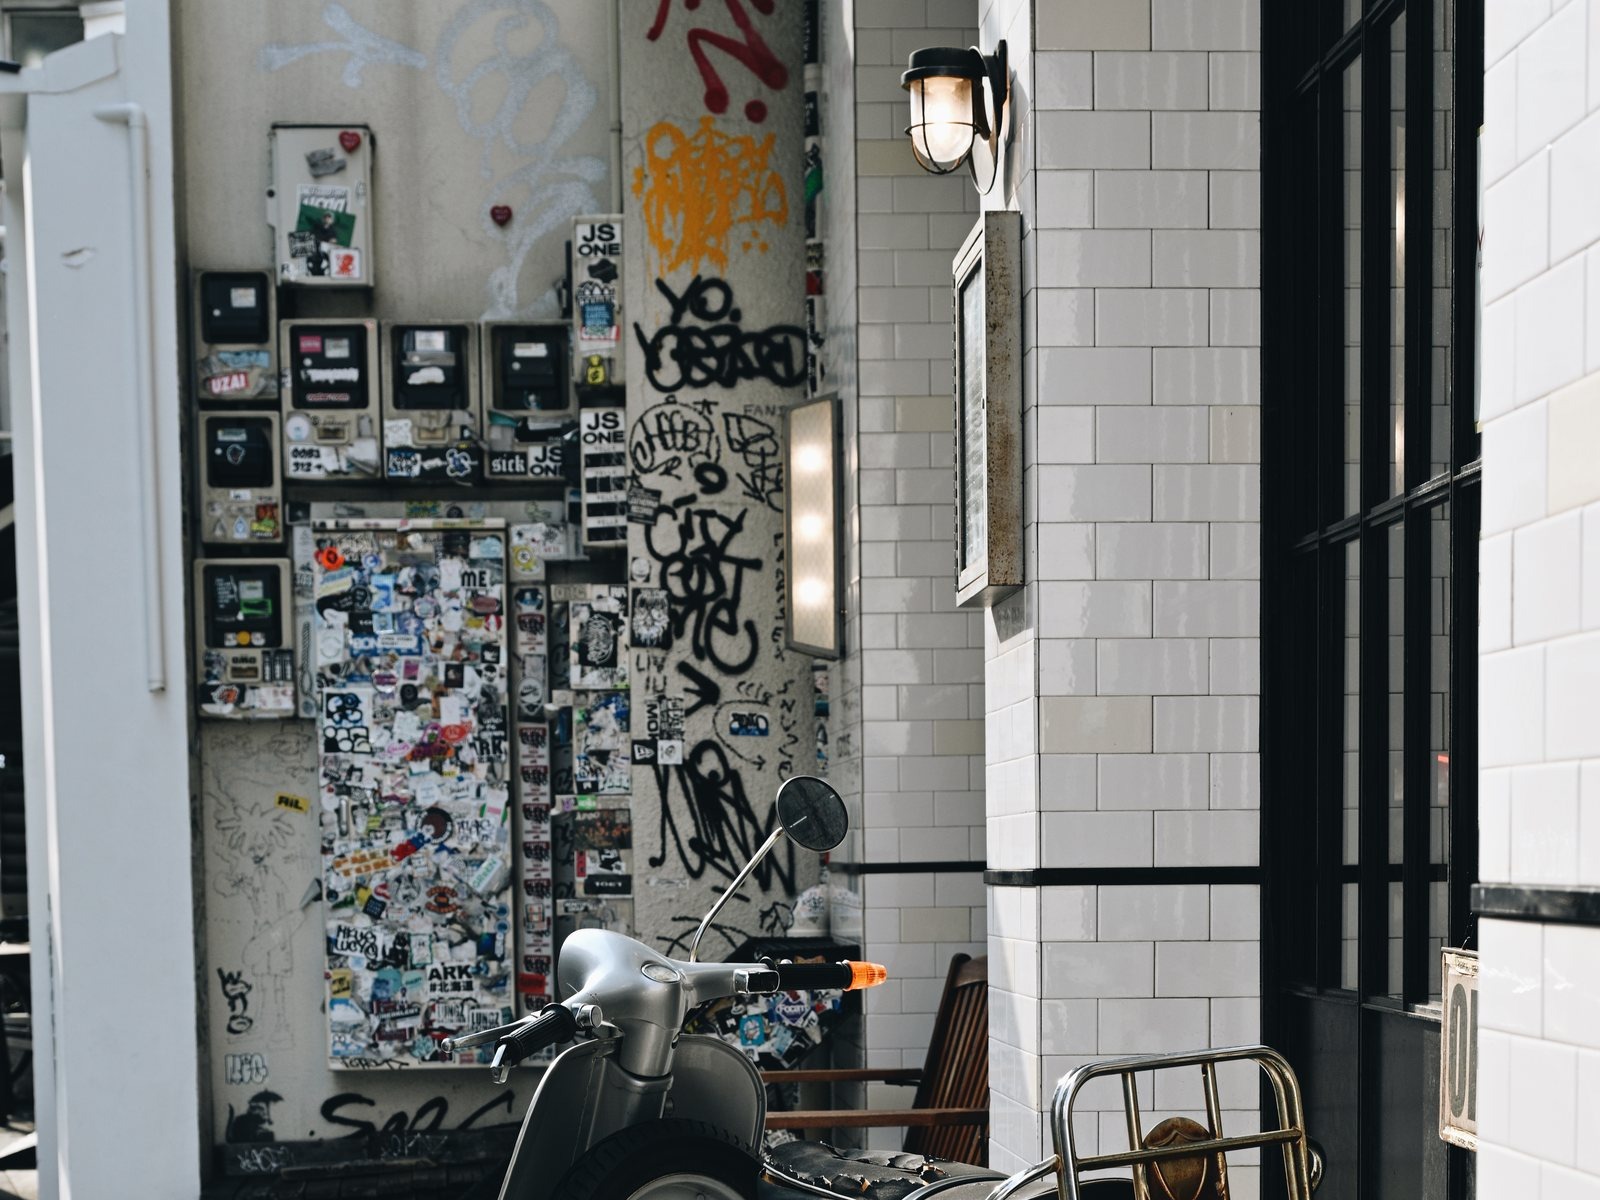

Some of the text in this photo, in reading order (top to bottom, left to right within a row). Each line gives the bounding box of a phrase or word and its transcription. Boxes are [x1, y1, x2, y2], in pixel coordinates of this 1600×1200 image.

[582, 223, 616, 243] JS
[578, 243, 621, 256] ONE
[211, 374, 246, 394] UZAI
[586, 411, 620, 431] JS
[582, 430, 625, 445] ONE
[428, 965, 473, 981] ARK
